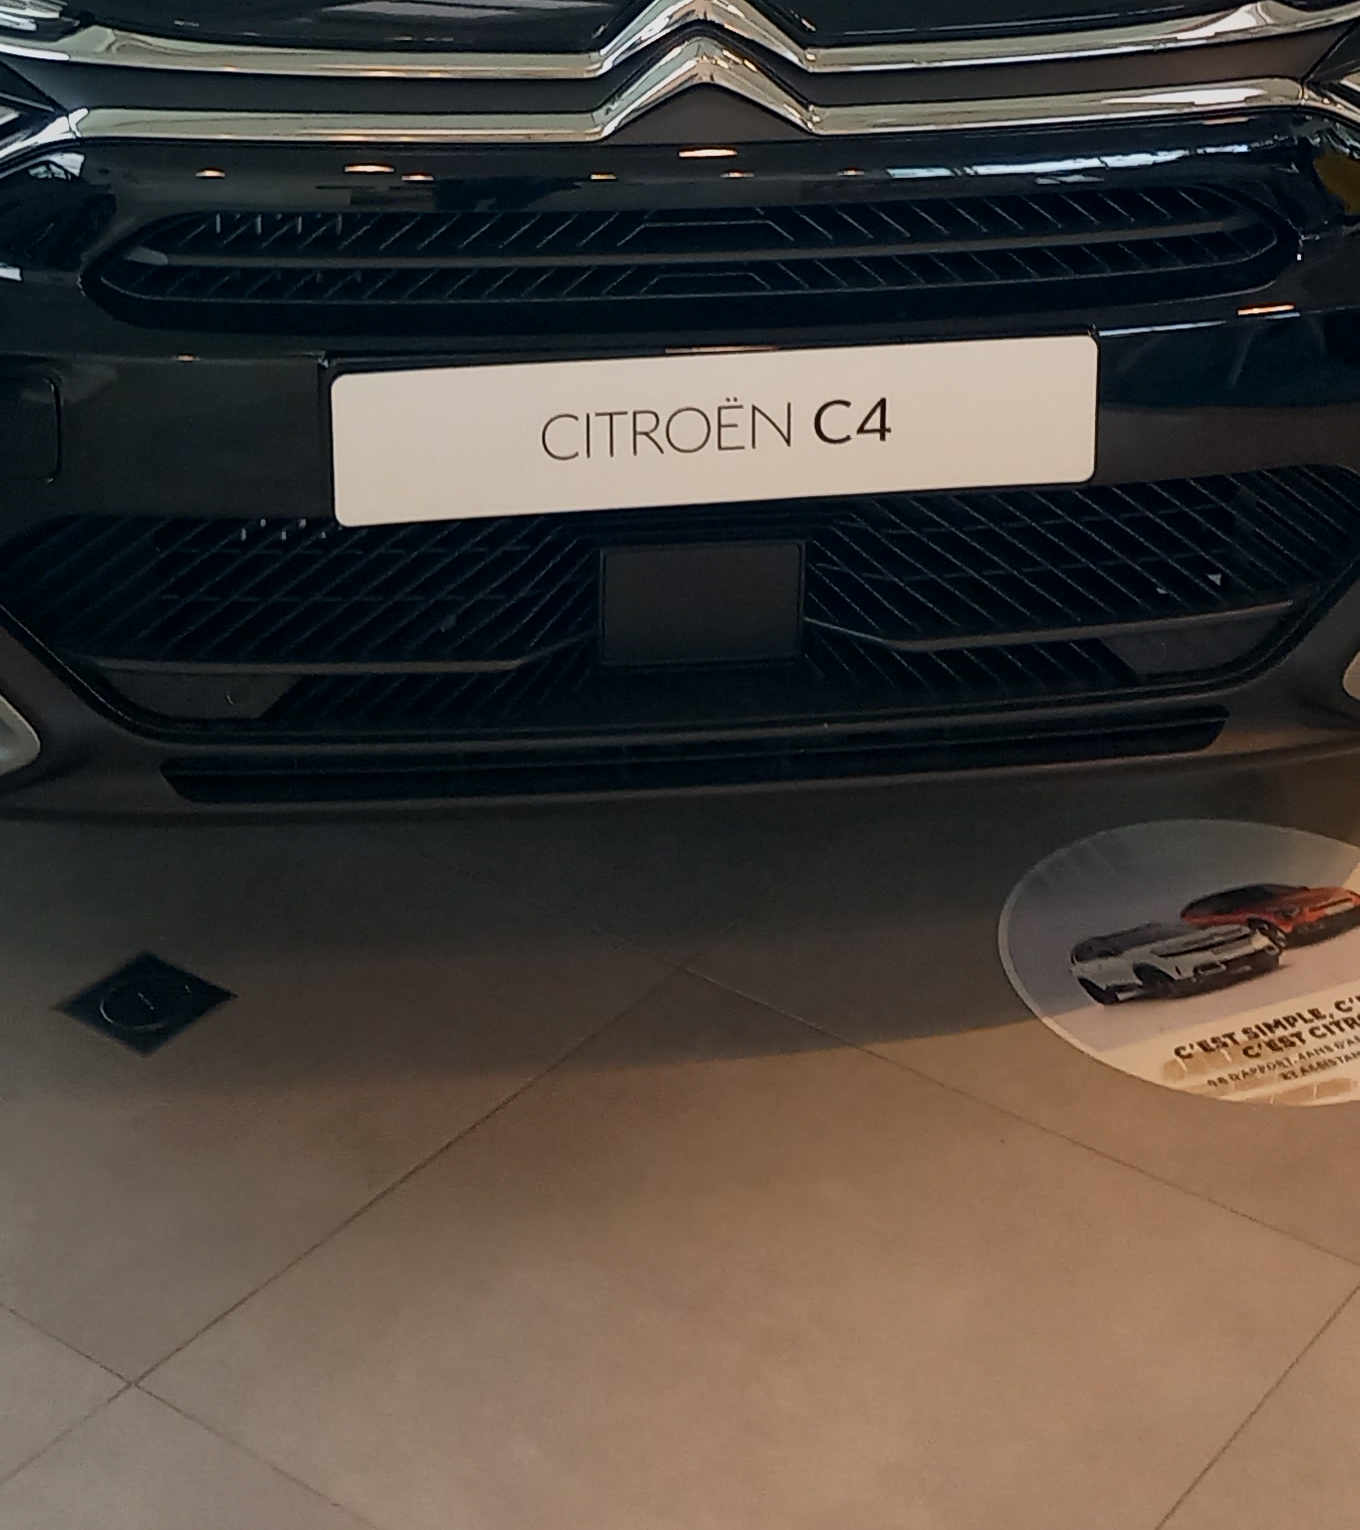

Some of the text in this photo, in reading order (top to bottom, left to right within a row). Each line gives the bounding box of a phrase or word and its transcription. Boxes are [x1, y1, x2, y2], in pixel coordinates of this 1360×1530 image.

[542, 397, 892, 460] CITROËN C4
[1173, 1032, 1241, 1060] C'EST
[1240, 1007, 1335, 1041] SIMPLE,
[1242, 1031, 1311, 1060] C'EST
